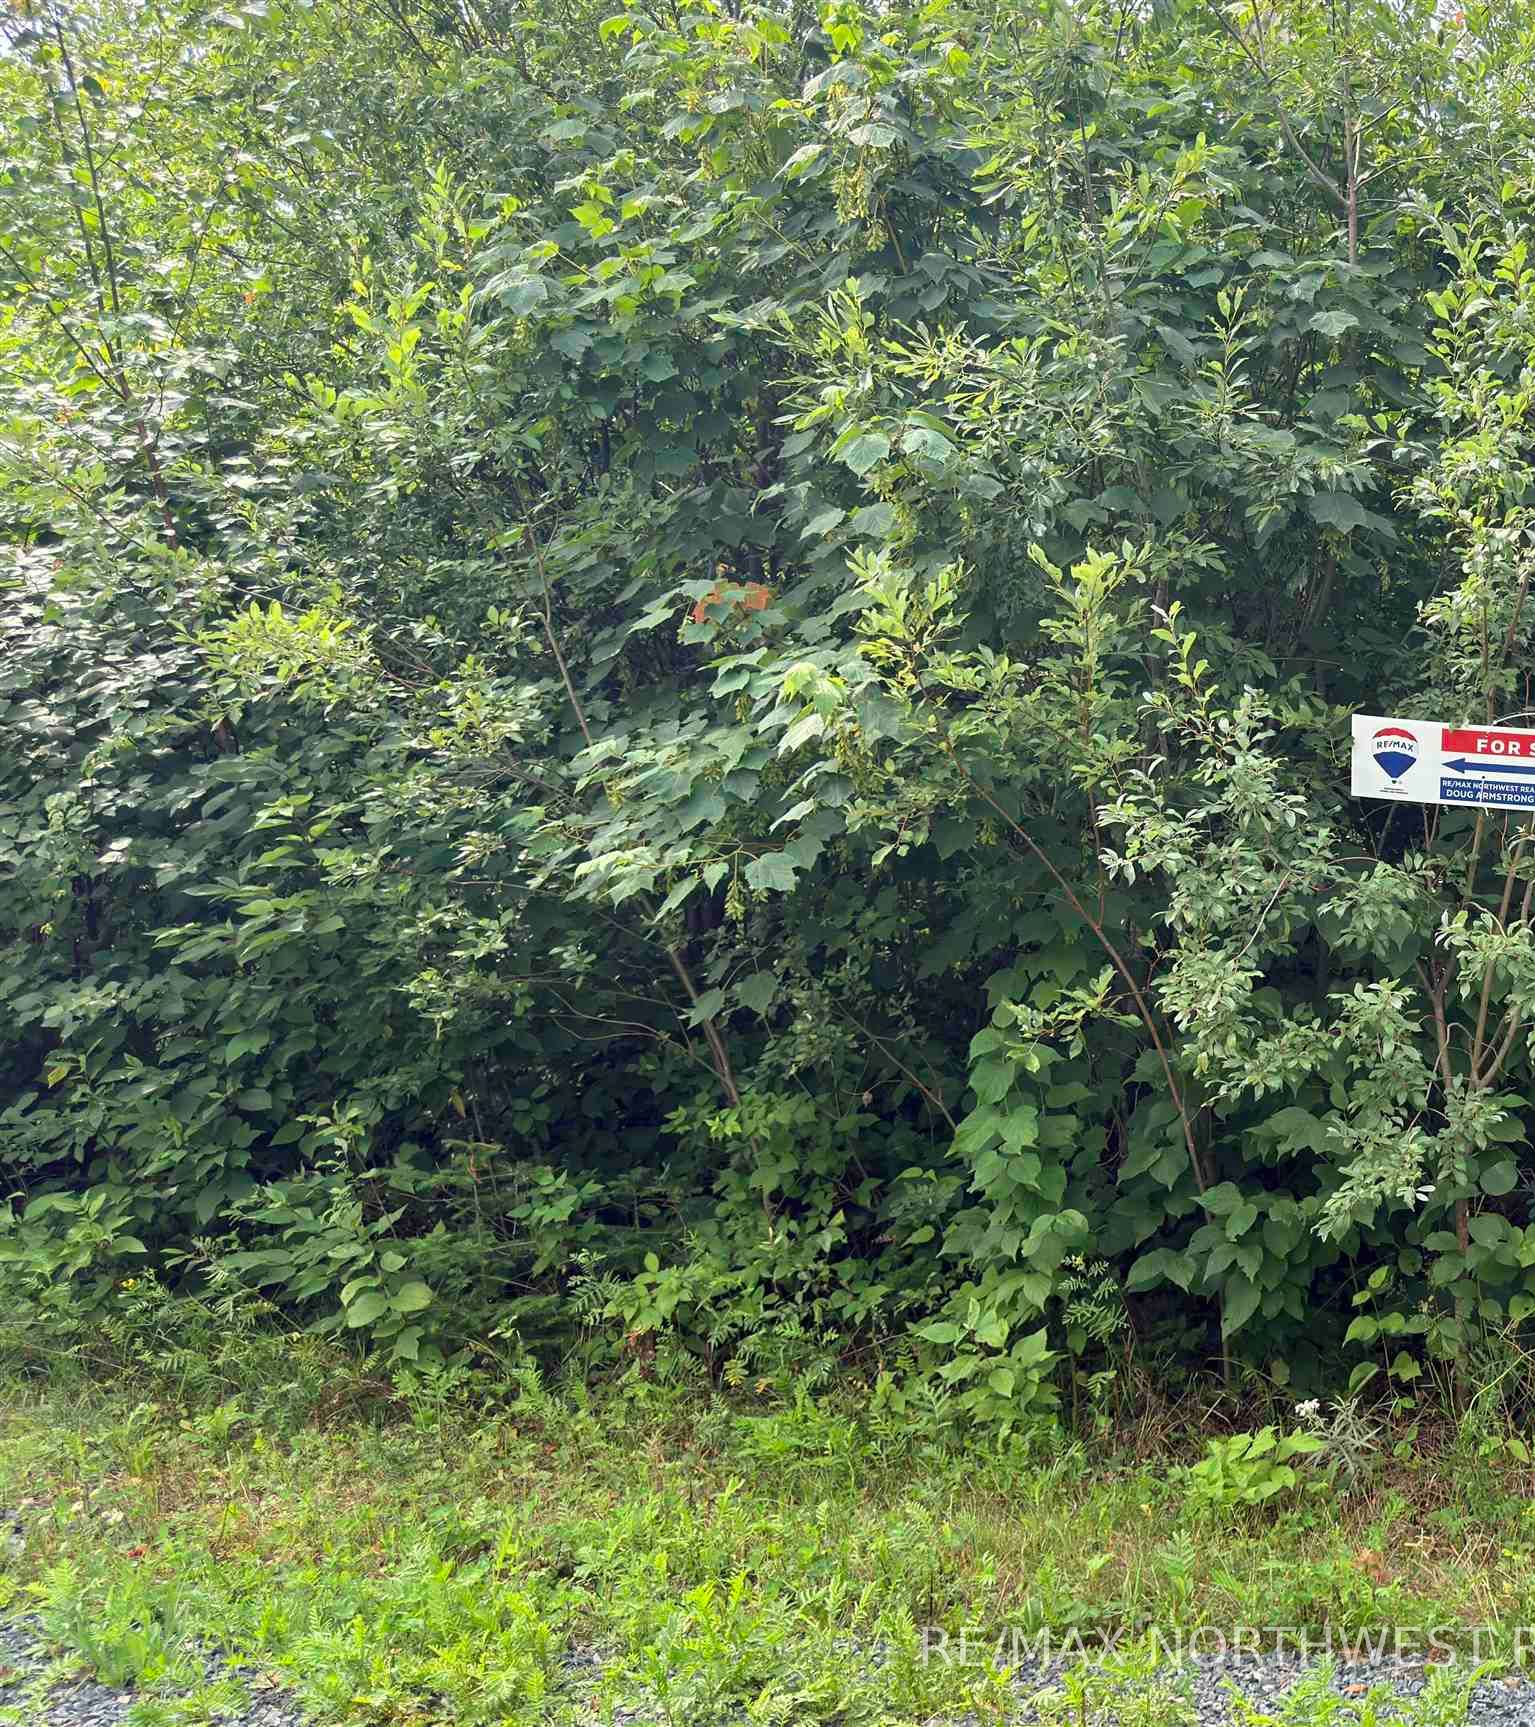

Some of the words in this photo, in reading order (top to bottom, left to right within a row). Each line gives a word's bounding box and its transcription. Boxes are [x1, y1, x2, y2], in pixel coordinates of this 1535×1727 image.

[1376, 740, 1414, 752] RE/MAX
[1476, 738, 1520, 755] FOR
[1442, 780, 1472, 788] RE/MAX
[1472, 782, 1520, 792] NORTHWEST
[1446, 789, 1474, 799] DOUG
[1476, 791, 1534, 803] ARMSTRONG
